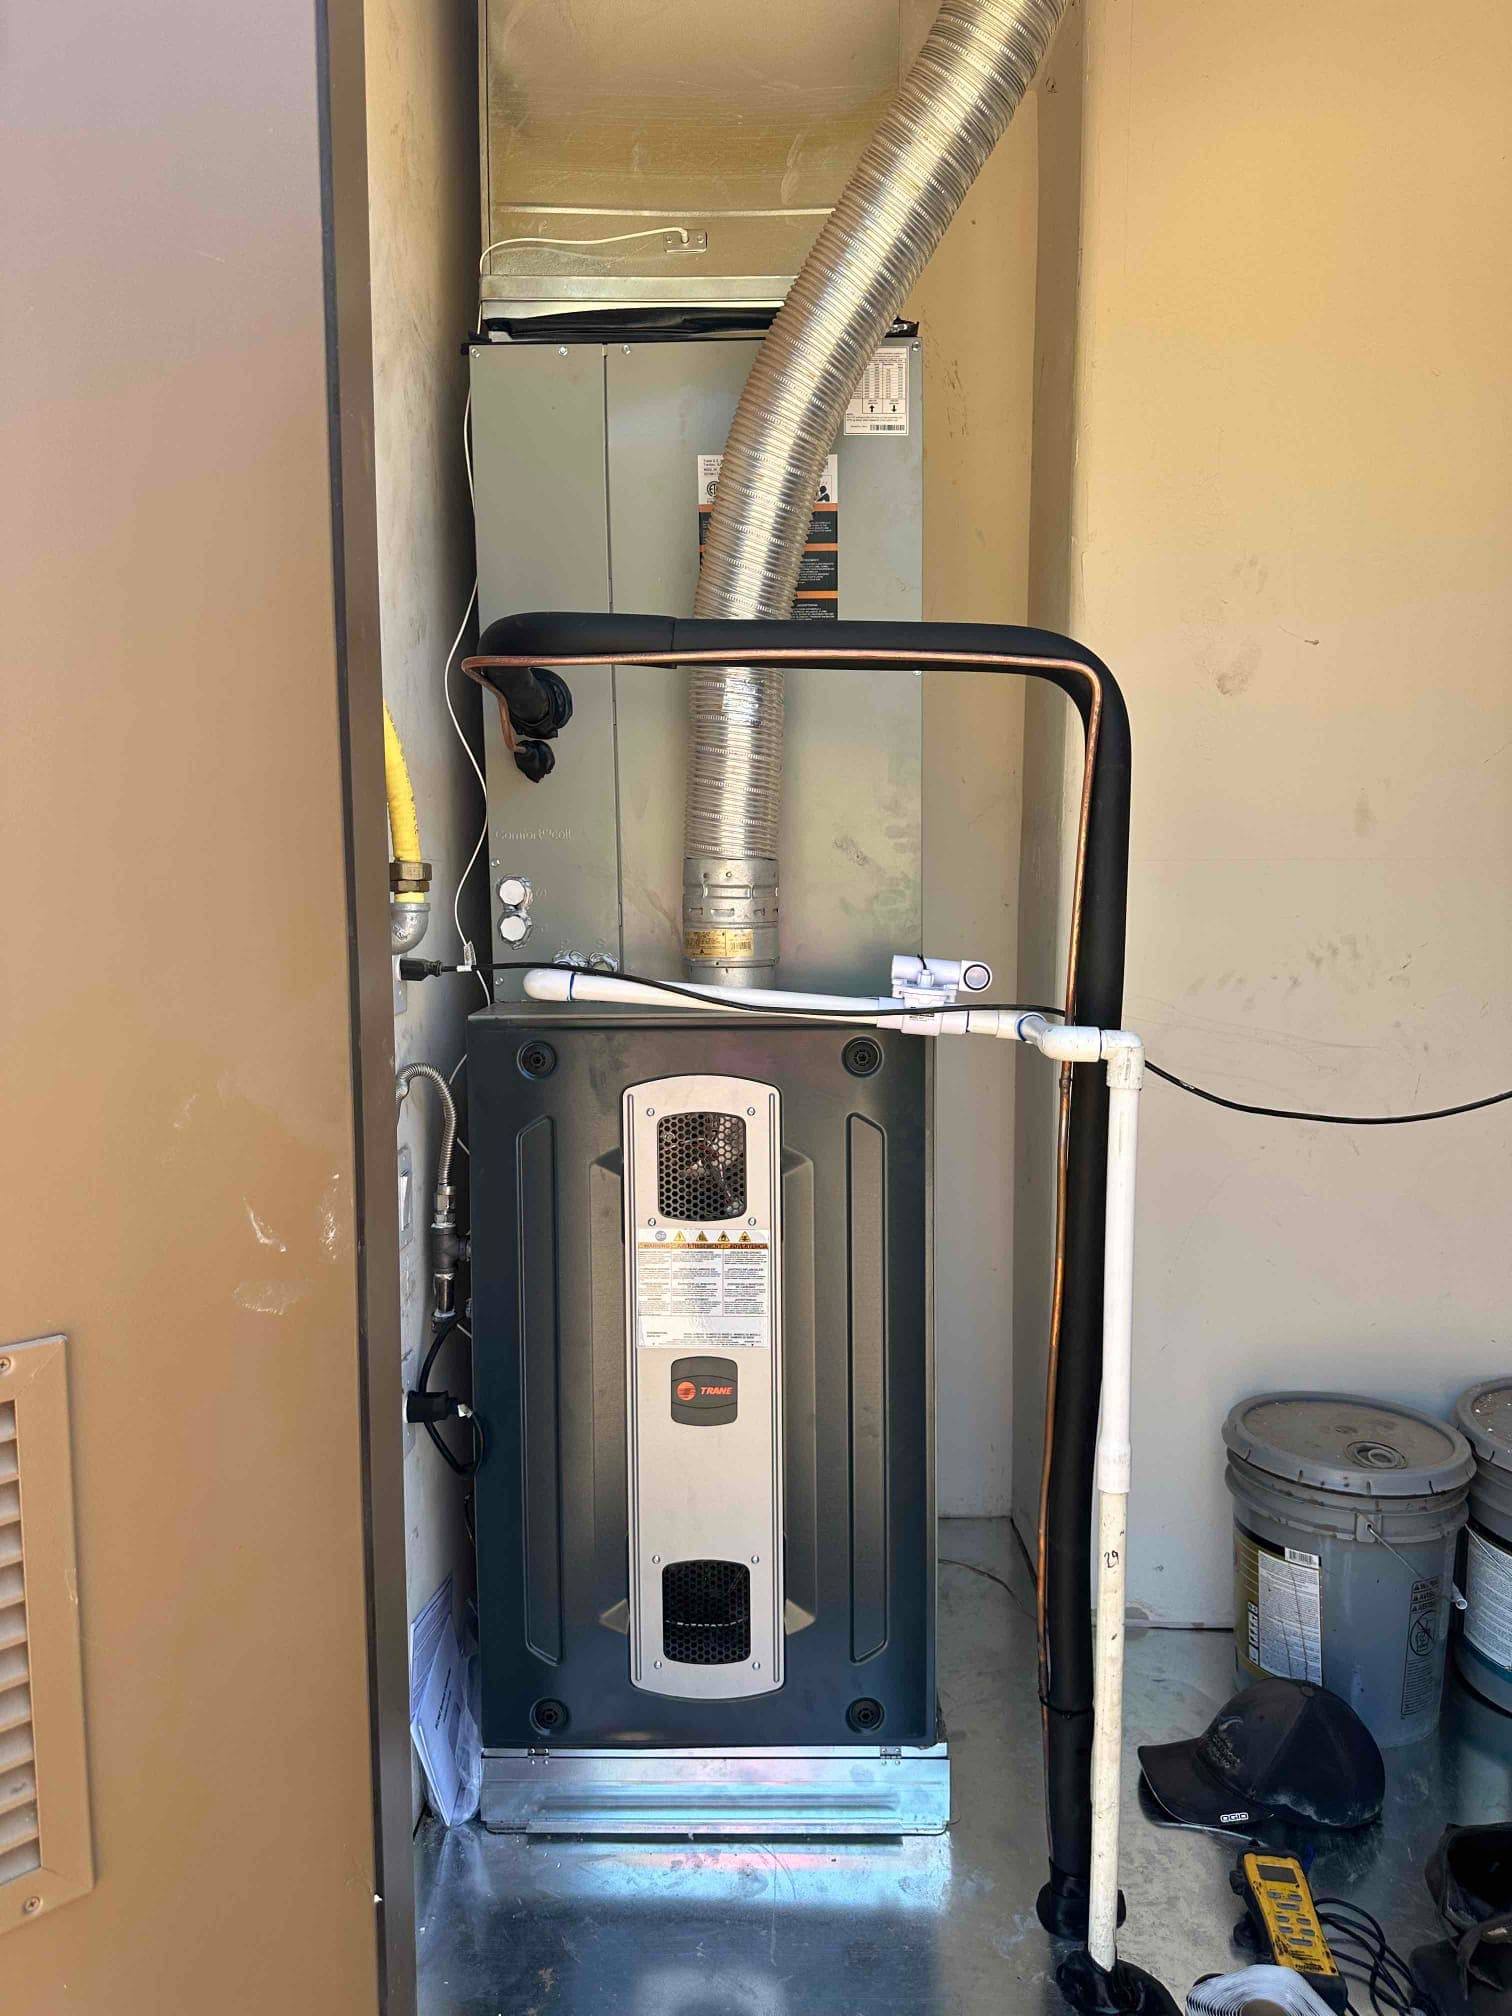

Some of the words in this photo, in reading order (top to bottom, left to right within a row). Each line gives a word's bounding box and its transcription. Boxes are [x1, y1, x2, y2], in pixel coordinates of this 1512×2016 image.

[700, 1386, 733, 1395] TRANE
[1103, 1550, 1119, 1569] 29
[1220, 1812, 1249, 1823] OGIO
